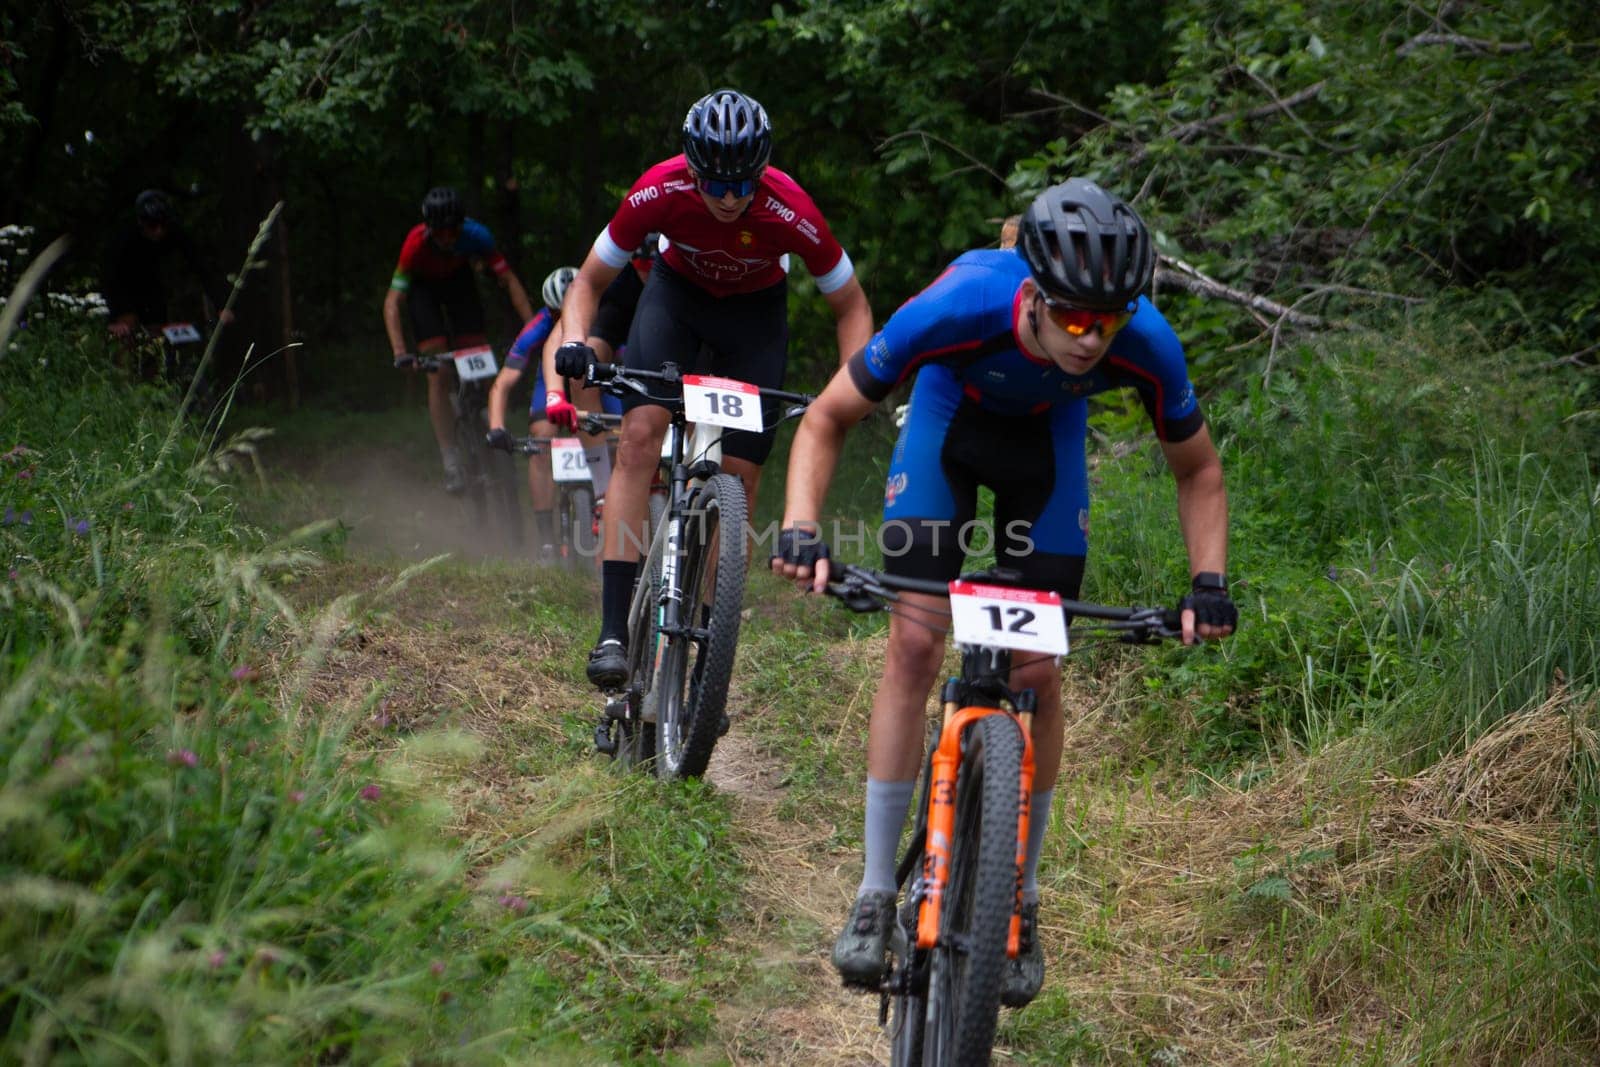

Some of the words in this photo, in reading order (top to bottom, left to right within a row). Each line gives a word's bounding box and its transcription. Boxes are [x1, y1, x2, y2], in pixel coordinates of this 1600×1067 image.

[628, 185, 659, 208] ТРИО
[765, 196, 796, 222] ТРИО
[466, 356, 486, 371] 15
[704, 392, 744, 418] 18
[562, 451, 587, 470] 20
[980, 605, 1038, 636] 12
